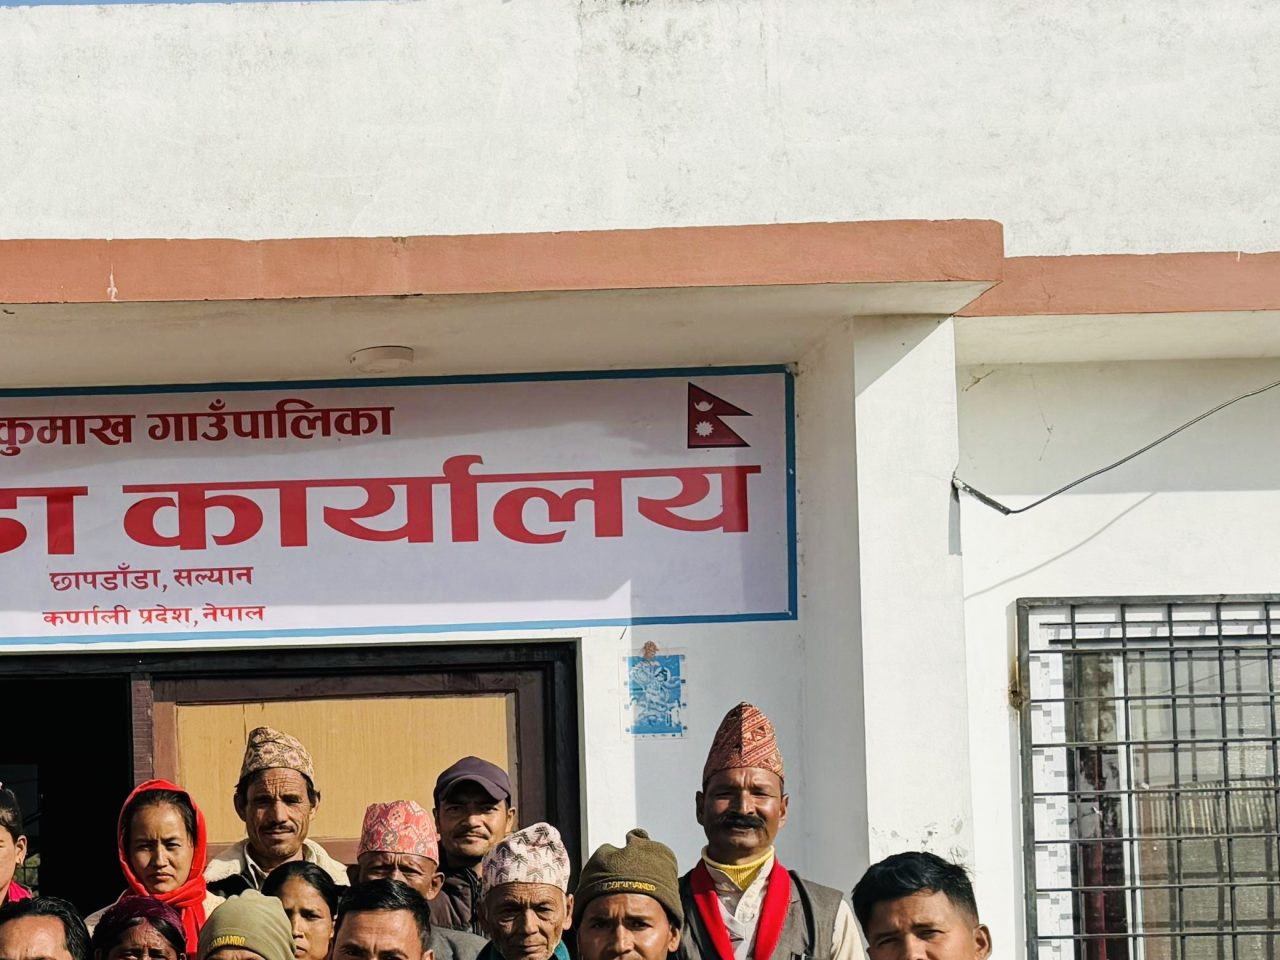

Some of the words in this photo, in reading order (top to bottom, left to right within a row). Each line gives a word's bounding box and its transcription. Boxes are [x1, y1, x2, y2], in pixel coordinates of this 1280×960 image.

[147, 398, 395, 443] गाउँपालिका
[122, 454, 761, 551] कार्यालय
[49, 562, 168, 593] छापडाँडा,
[173, 566, 254, 587] सल्यान
[42, 604, 131, 626] कर्णाली
[139, 604, 199, 627] प्रदेश,
[202, 603, 266, 623] नेपाल
